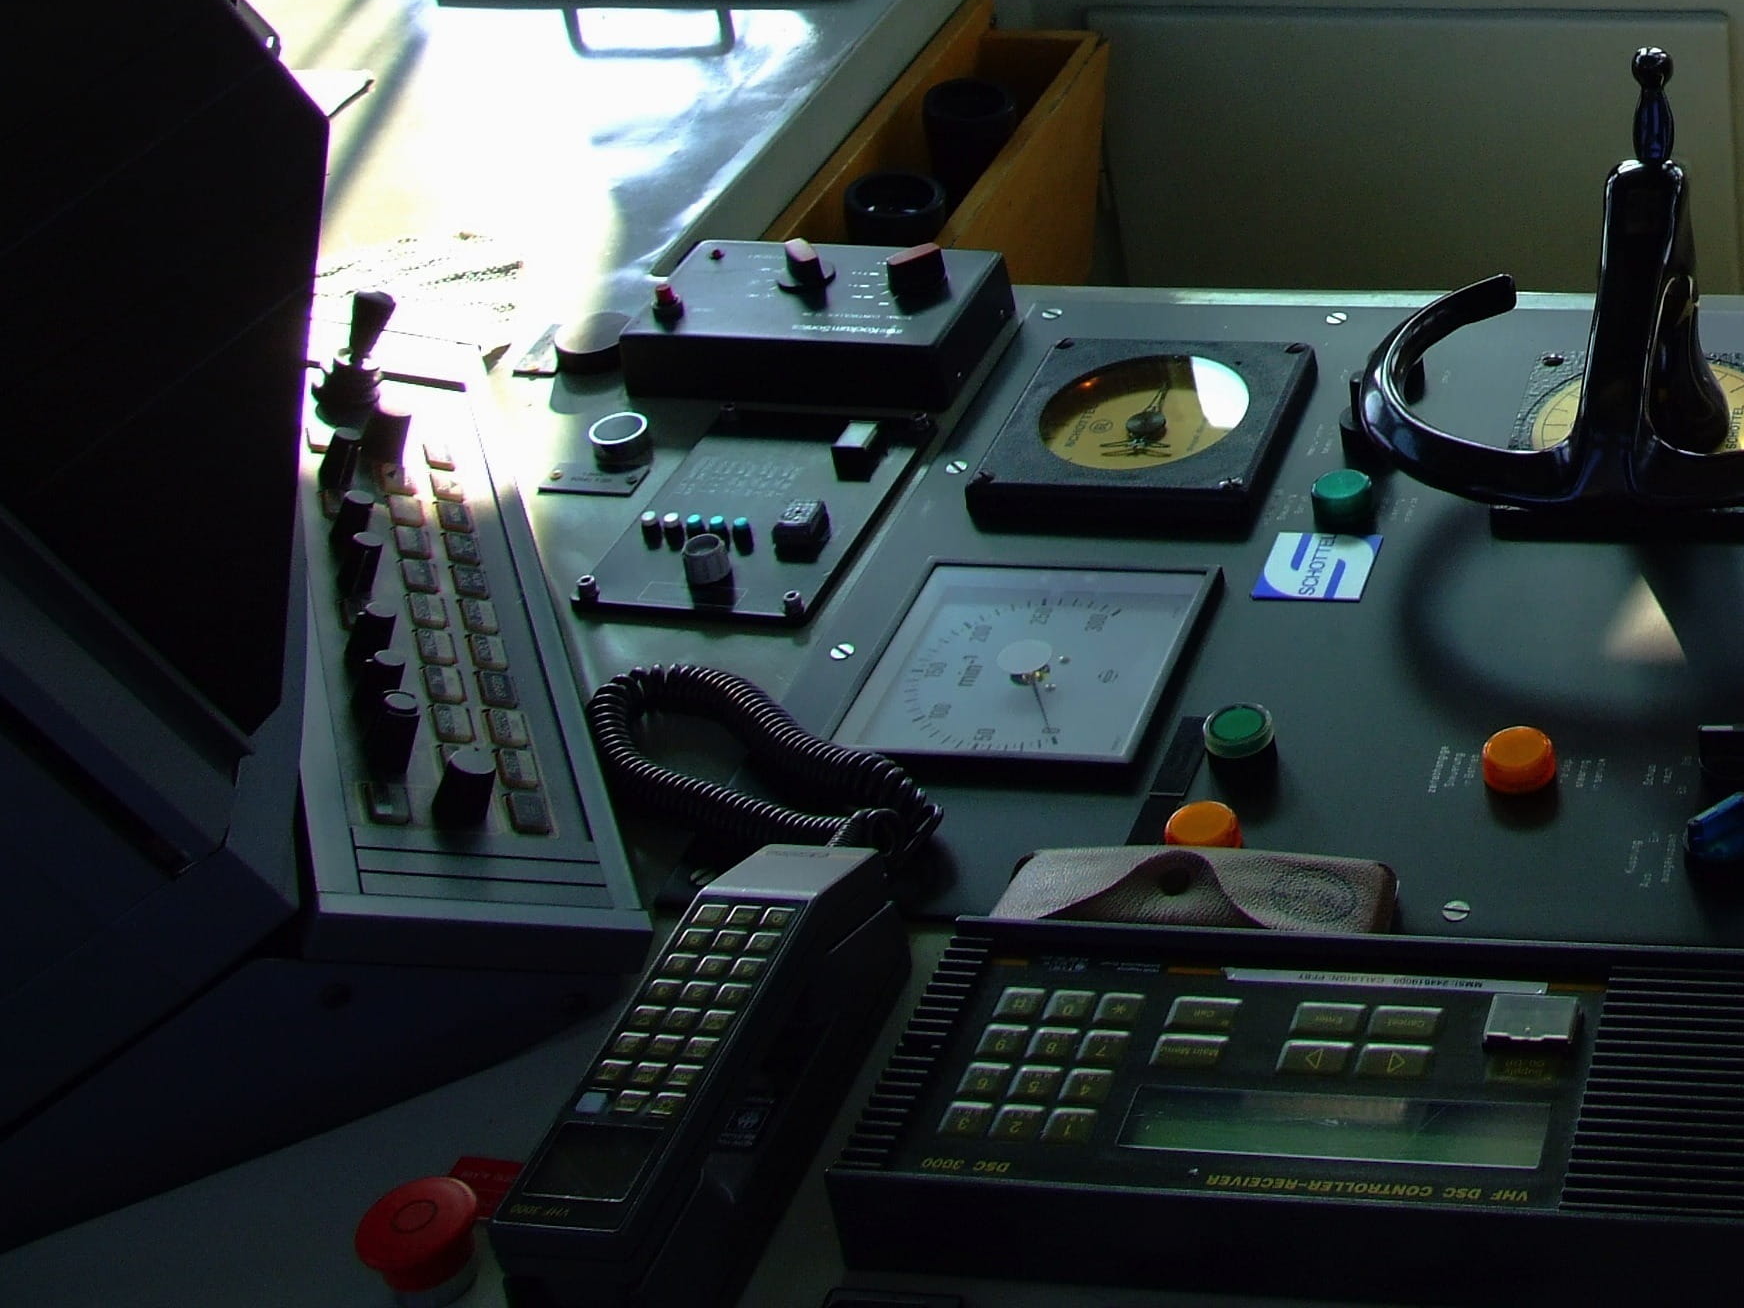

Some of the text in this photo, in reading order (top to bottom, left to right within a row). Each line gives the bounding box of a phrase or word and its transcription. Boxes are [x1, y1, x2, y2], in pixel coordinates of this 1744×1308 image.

[1724, 404, 1744, 450] SCHOTTEL
[1298, 534, 1337, 596] SCHOTTEL
[919, 1157, 1011, 1173] DSC 3000
[1205, 1173, 1529, 1202] VHF DSC CONTROLLER-RECEIVER
